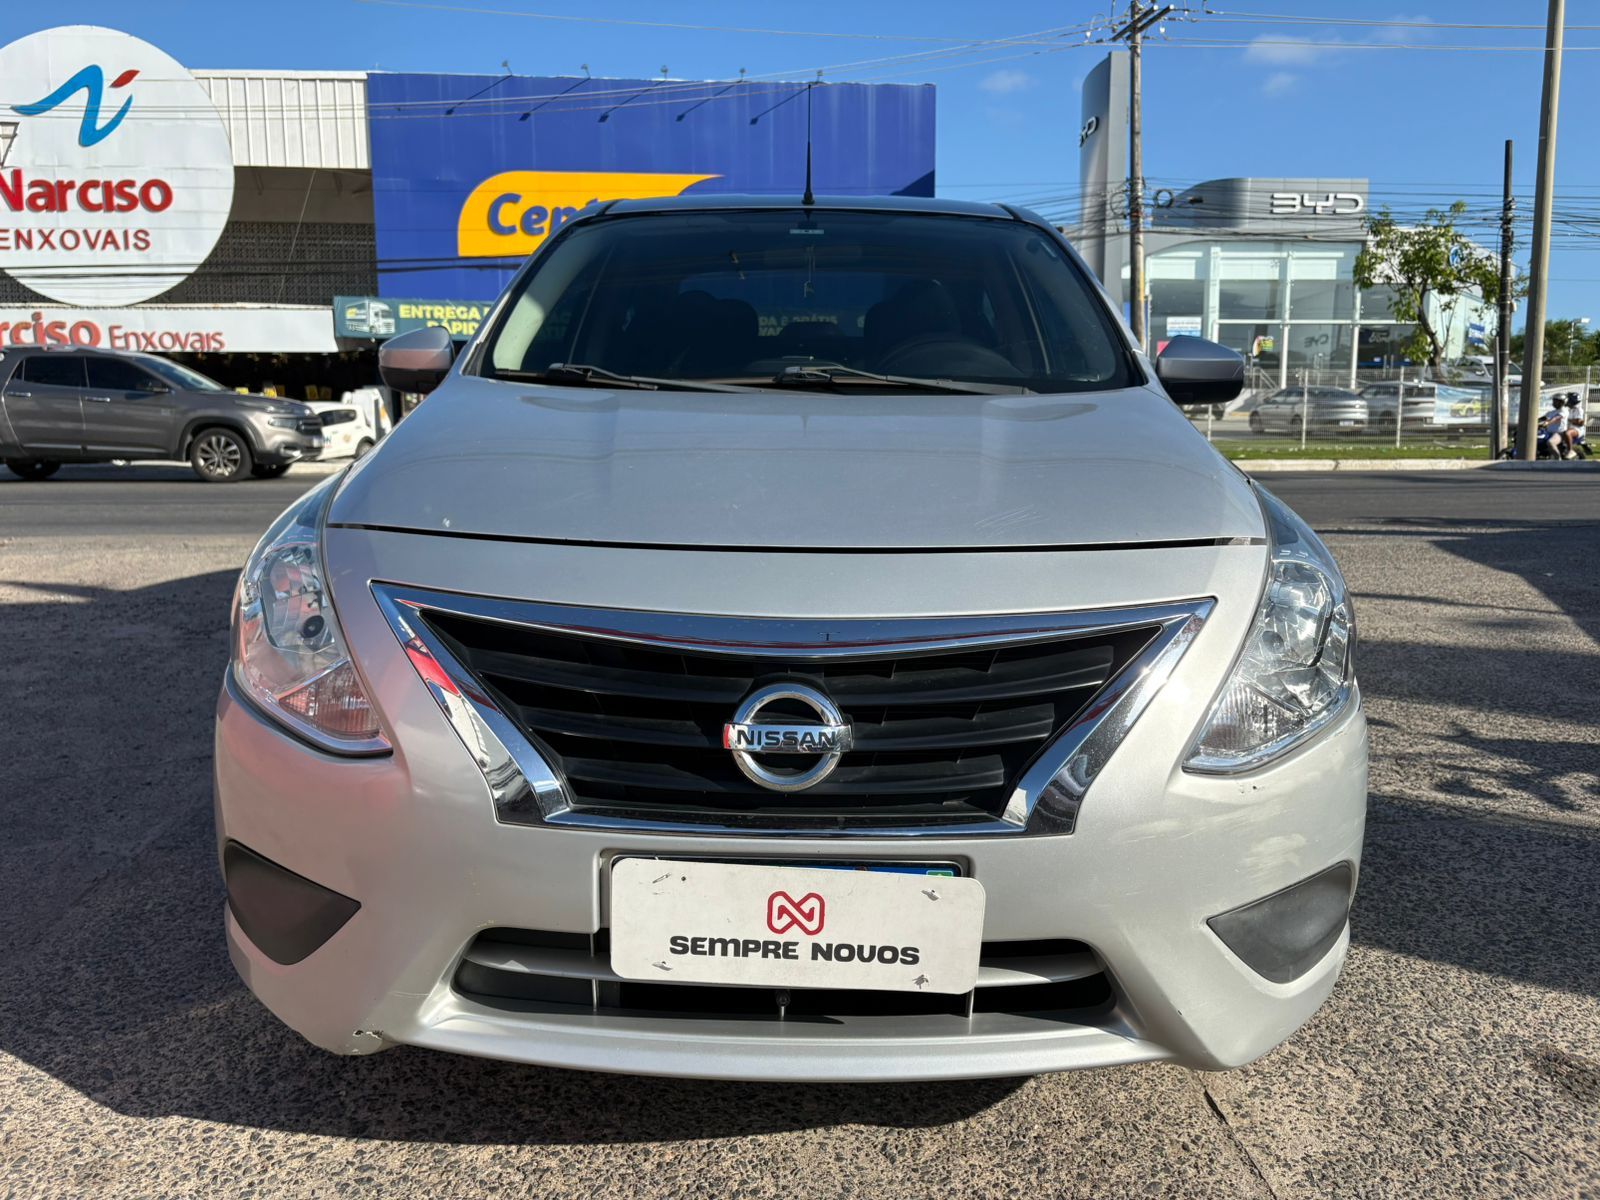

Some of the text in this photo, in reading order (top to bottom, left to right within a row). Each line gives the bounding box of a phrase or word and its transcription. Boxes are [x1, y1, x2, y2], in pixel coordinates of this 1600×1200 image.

[0, 169, 174, 213] Narciso
[1270, 192, 1364, 214] BYD
[0, 229, 151, 251] ENXOVAIS
[399, 304, 481, 320] ENTREGA
[108, 325, 225, 351] Enxovais
[736, 730, 837, 747] NISSAN
[669, 935, 800, 960] SEMPRE
